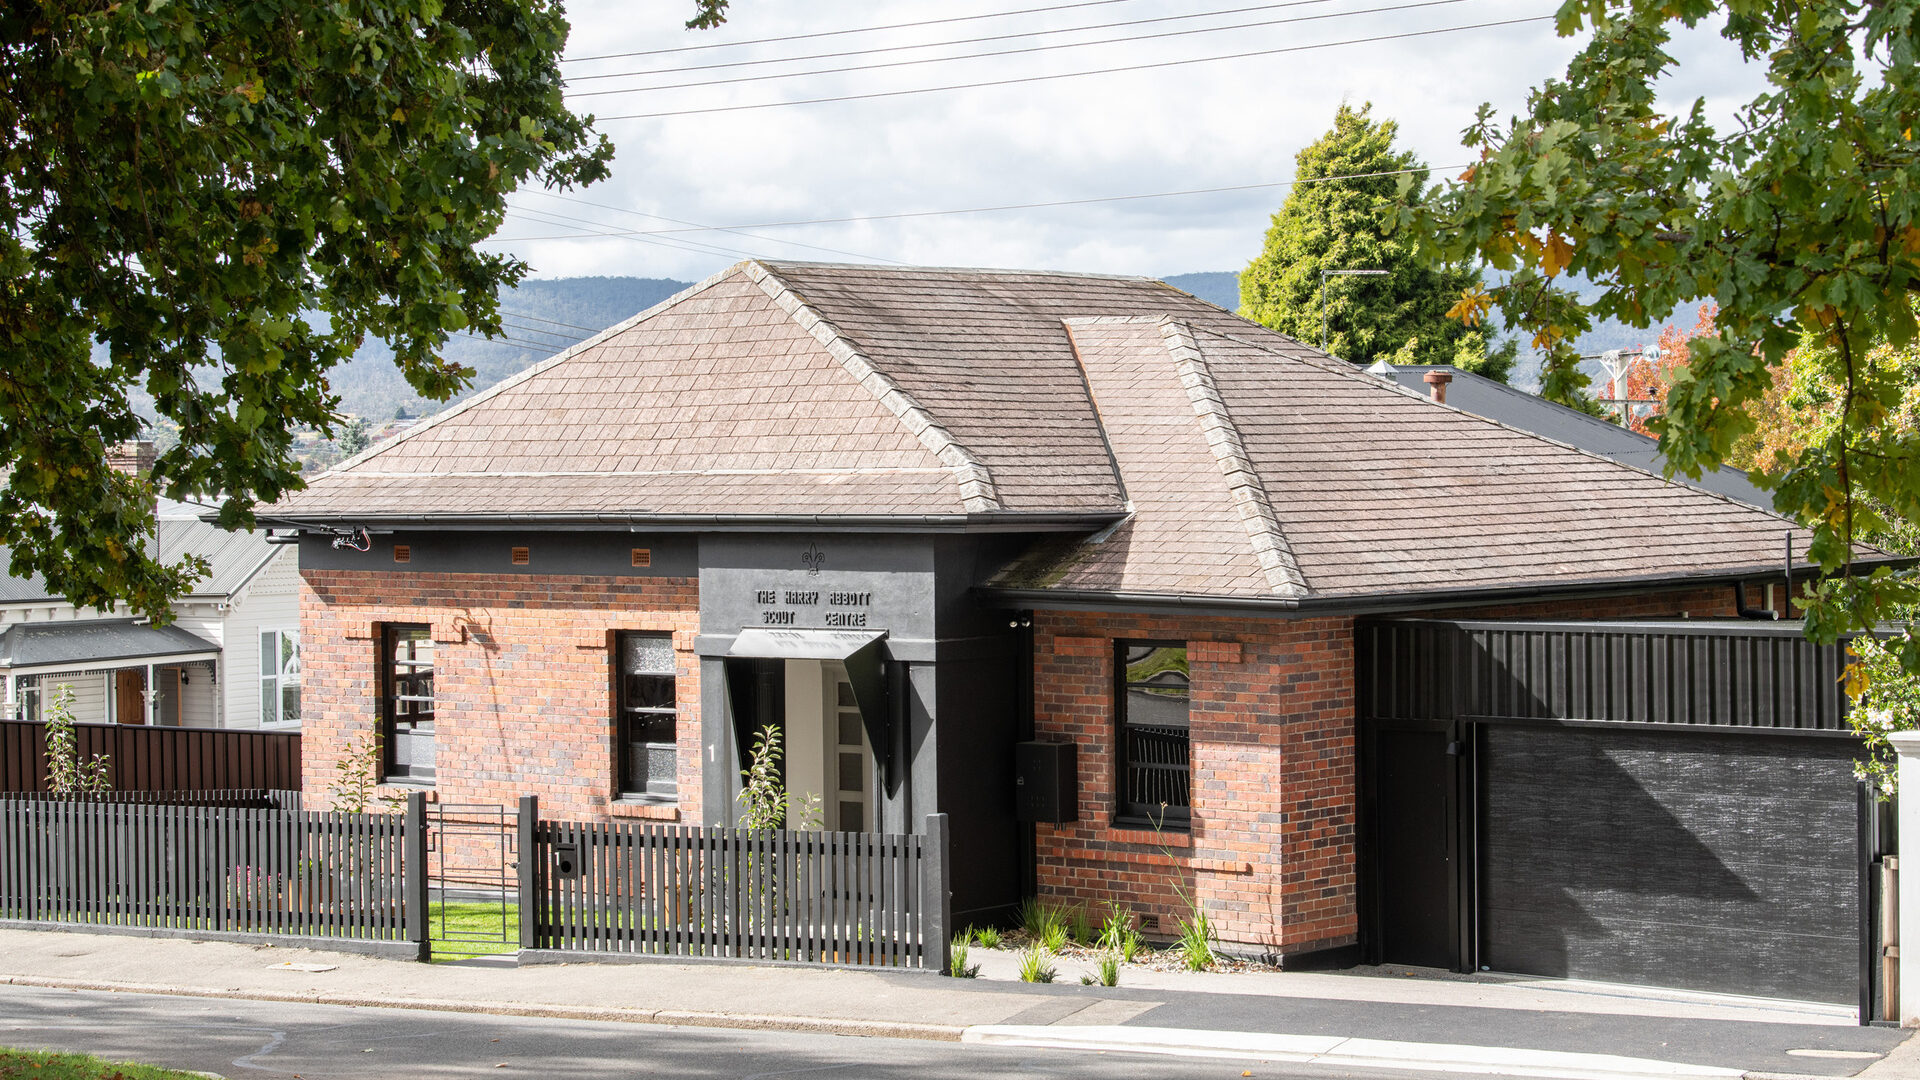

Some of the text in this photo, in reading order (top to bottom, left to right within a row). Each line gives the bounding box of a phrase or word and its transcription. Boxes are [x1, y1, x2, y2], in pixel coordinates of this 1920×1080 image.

[755, 590, 871, 606] THE HARRY ABBOTT
[762, 611, 866, 626] SCOUT CENTRE
[708, 743, 715, 762] 1
[554, 851, 560, 866] 1
